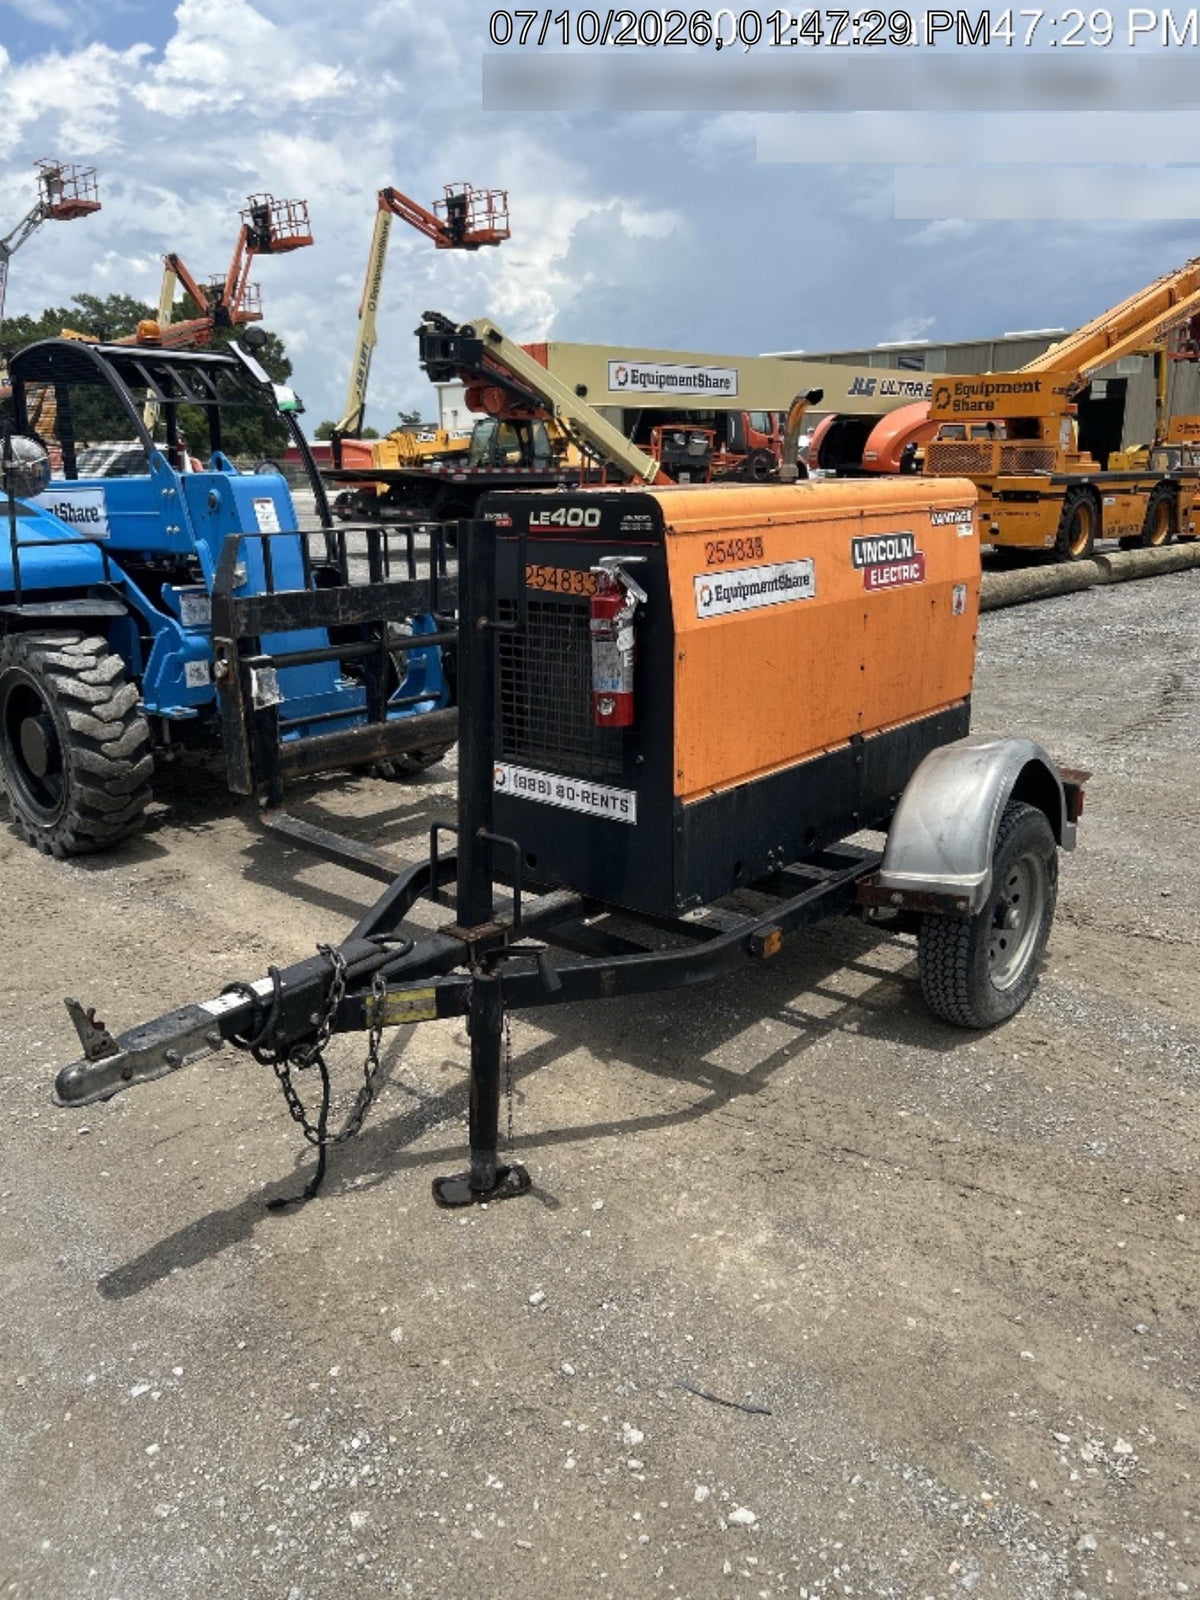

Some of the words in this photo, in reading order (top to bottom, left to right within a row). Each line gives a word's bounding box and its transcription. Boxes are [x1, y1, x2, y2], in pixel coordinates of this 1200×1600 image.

[630, 369, 731, 390] EquipmentShare
[954, 379, 1042, 398] Equipment
[953, 399, 994, 412] Share
[529, 508, 601, 528] LE400
[854, 537, 913, 565] LINCOLN
[870, 563, 921, 586] ELECTRIC
[714, 574, 810, 603] EquipmentShare
[556, 784, 629, 813] 80-RENTS
